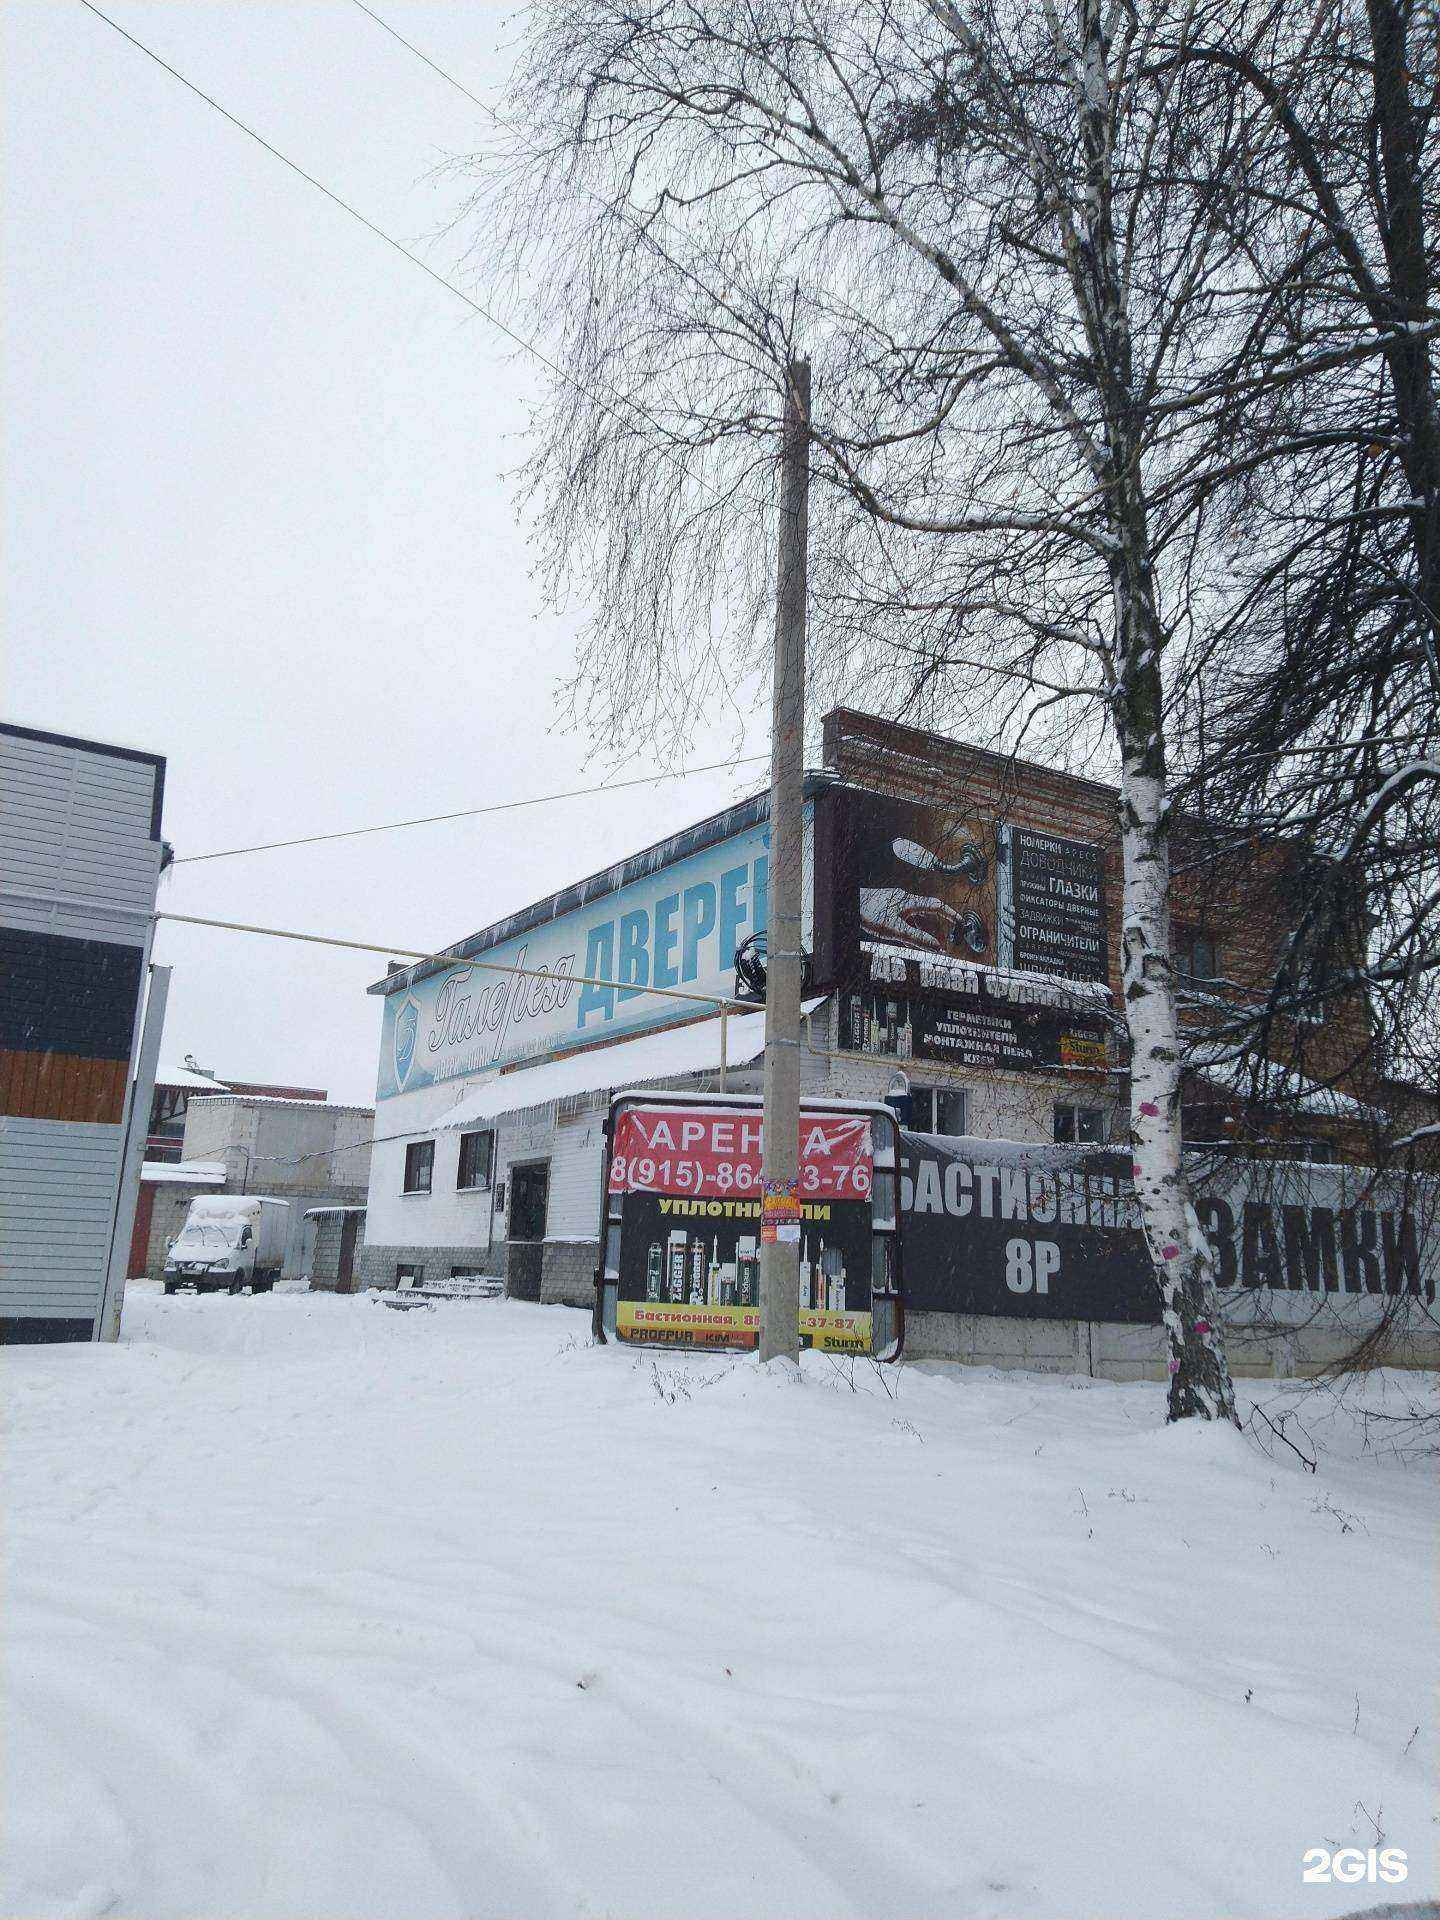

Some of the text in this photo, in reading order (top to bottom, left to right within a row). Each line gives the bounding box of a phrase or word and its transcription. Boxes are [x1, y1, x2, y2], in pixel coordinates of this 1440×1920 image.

[1049, 876, 1098, 902] ГЛАЗКИ
[1020, 893, 1100, 917] ФИКСАТОРЫ ДВЕРНЫЕ
[1020, 925, 1100, 952] ОГРАНИЧИТЕЛИ
[648, 1120, 832, 1156] АРЕНА
[658, 1198, 831, 1221] УПЛОТНИЛИ
[1005, 1238, 1061, 1294] 8Р
[634, 1309, 737, 1326] Бастионная,
[824, 1336, 864, 1351] Sturm
